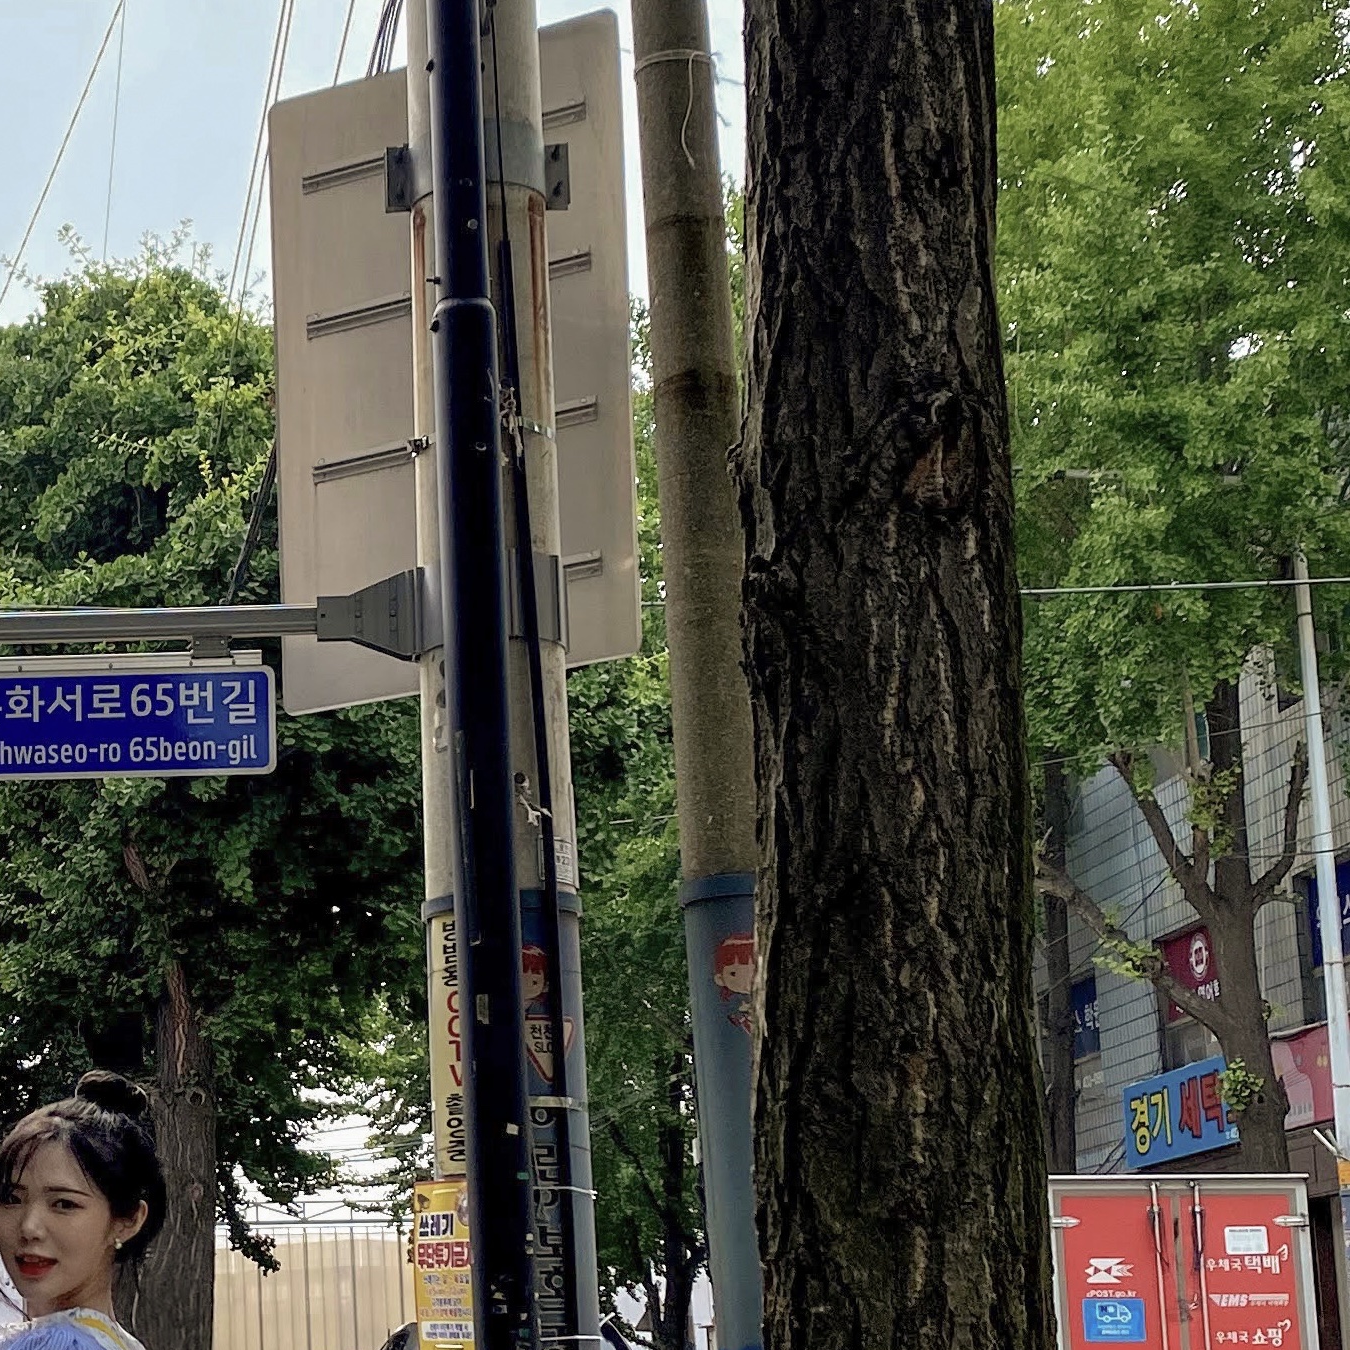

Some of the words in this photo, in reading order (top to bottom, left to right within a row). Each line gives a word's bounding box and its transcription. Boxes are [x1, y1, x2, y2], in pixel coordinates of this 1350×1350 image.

[130, 734, 257, 766] 65beon-gil
[1131, 1086, 1172, 1155] 경기
[419, 1213, 454, 1237] 쓰레기
[1206, 1258, 1242, 1271] 우체국
[1244, 1255, 1280, 1274] 택배
[1221, 1293, 1249, 1307] EMS
[1216, 1331, 1248, 1344] 우체국
[1252, 1328, 1282, 1347] 쇼핑
